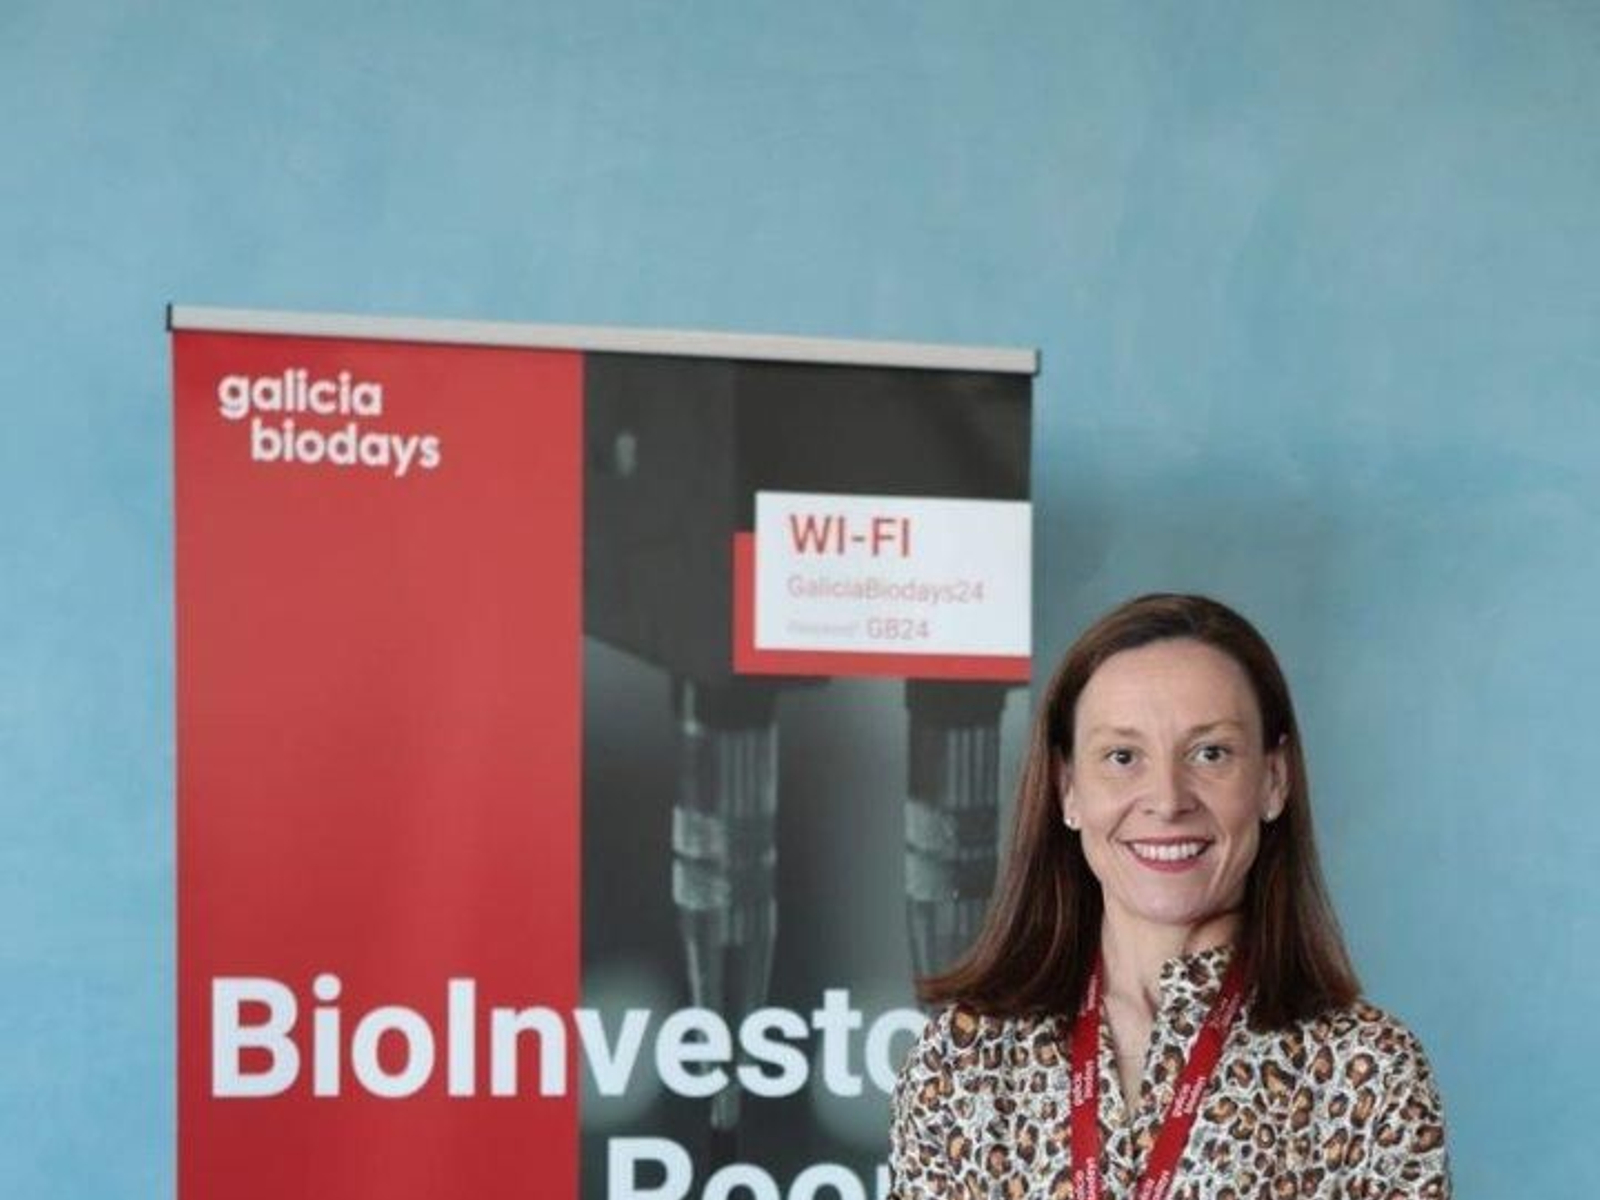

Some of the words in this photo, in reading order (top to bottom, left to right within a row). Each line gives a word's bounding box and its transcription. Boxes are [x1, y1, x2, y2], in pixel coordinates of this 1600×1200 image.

[217, 368, 383, 419] galicia
[250, 418, 441, 477] biodays
[789, 513, 911, 558] WI-FI
[786, 575, 985, 605] GaliciaBiodays24
